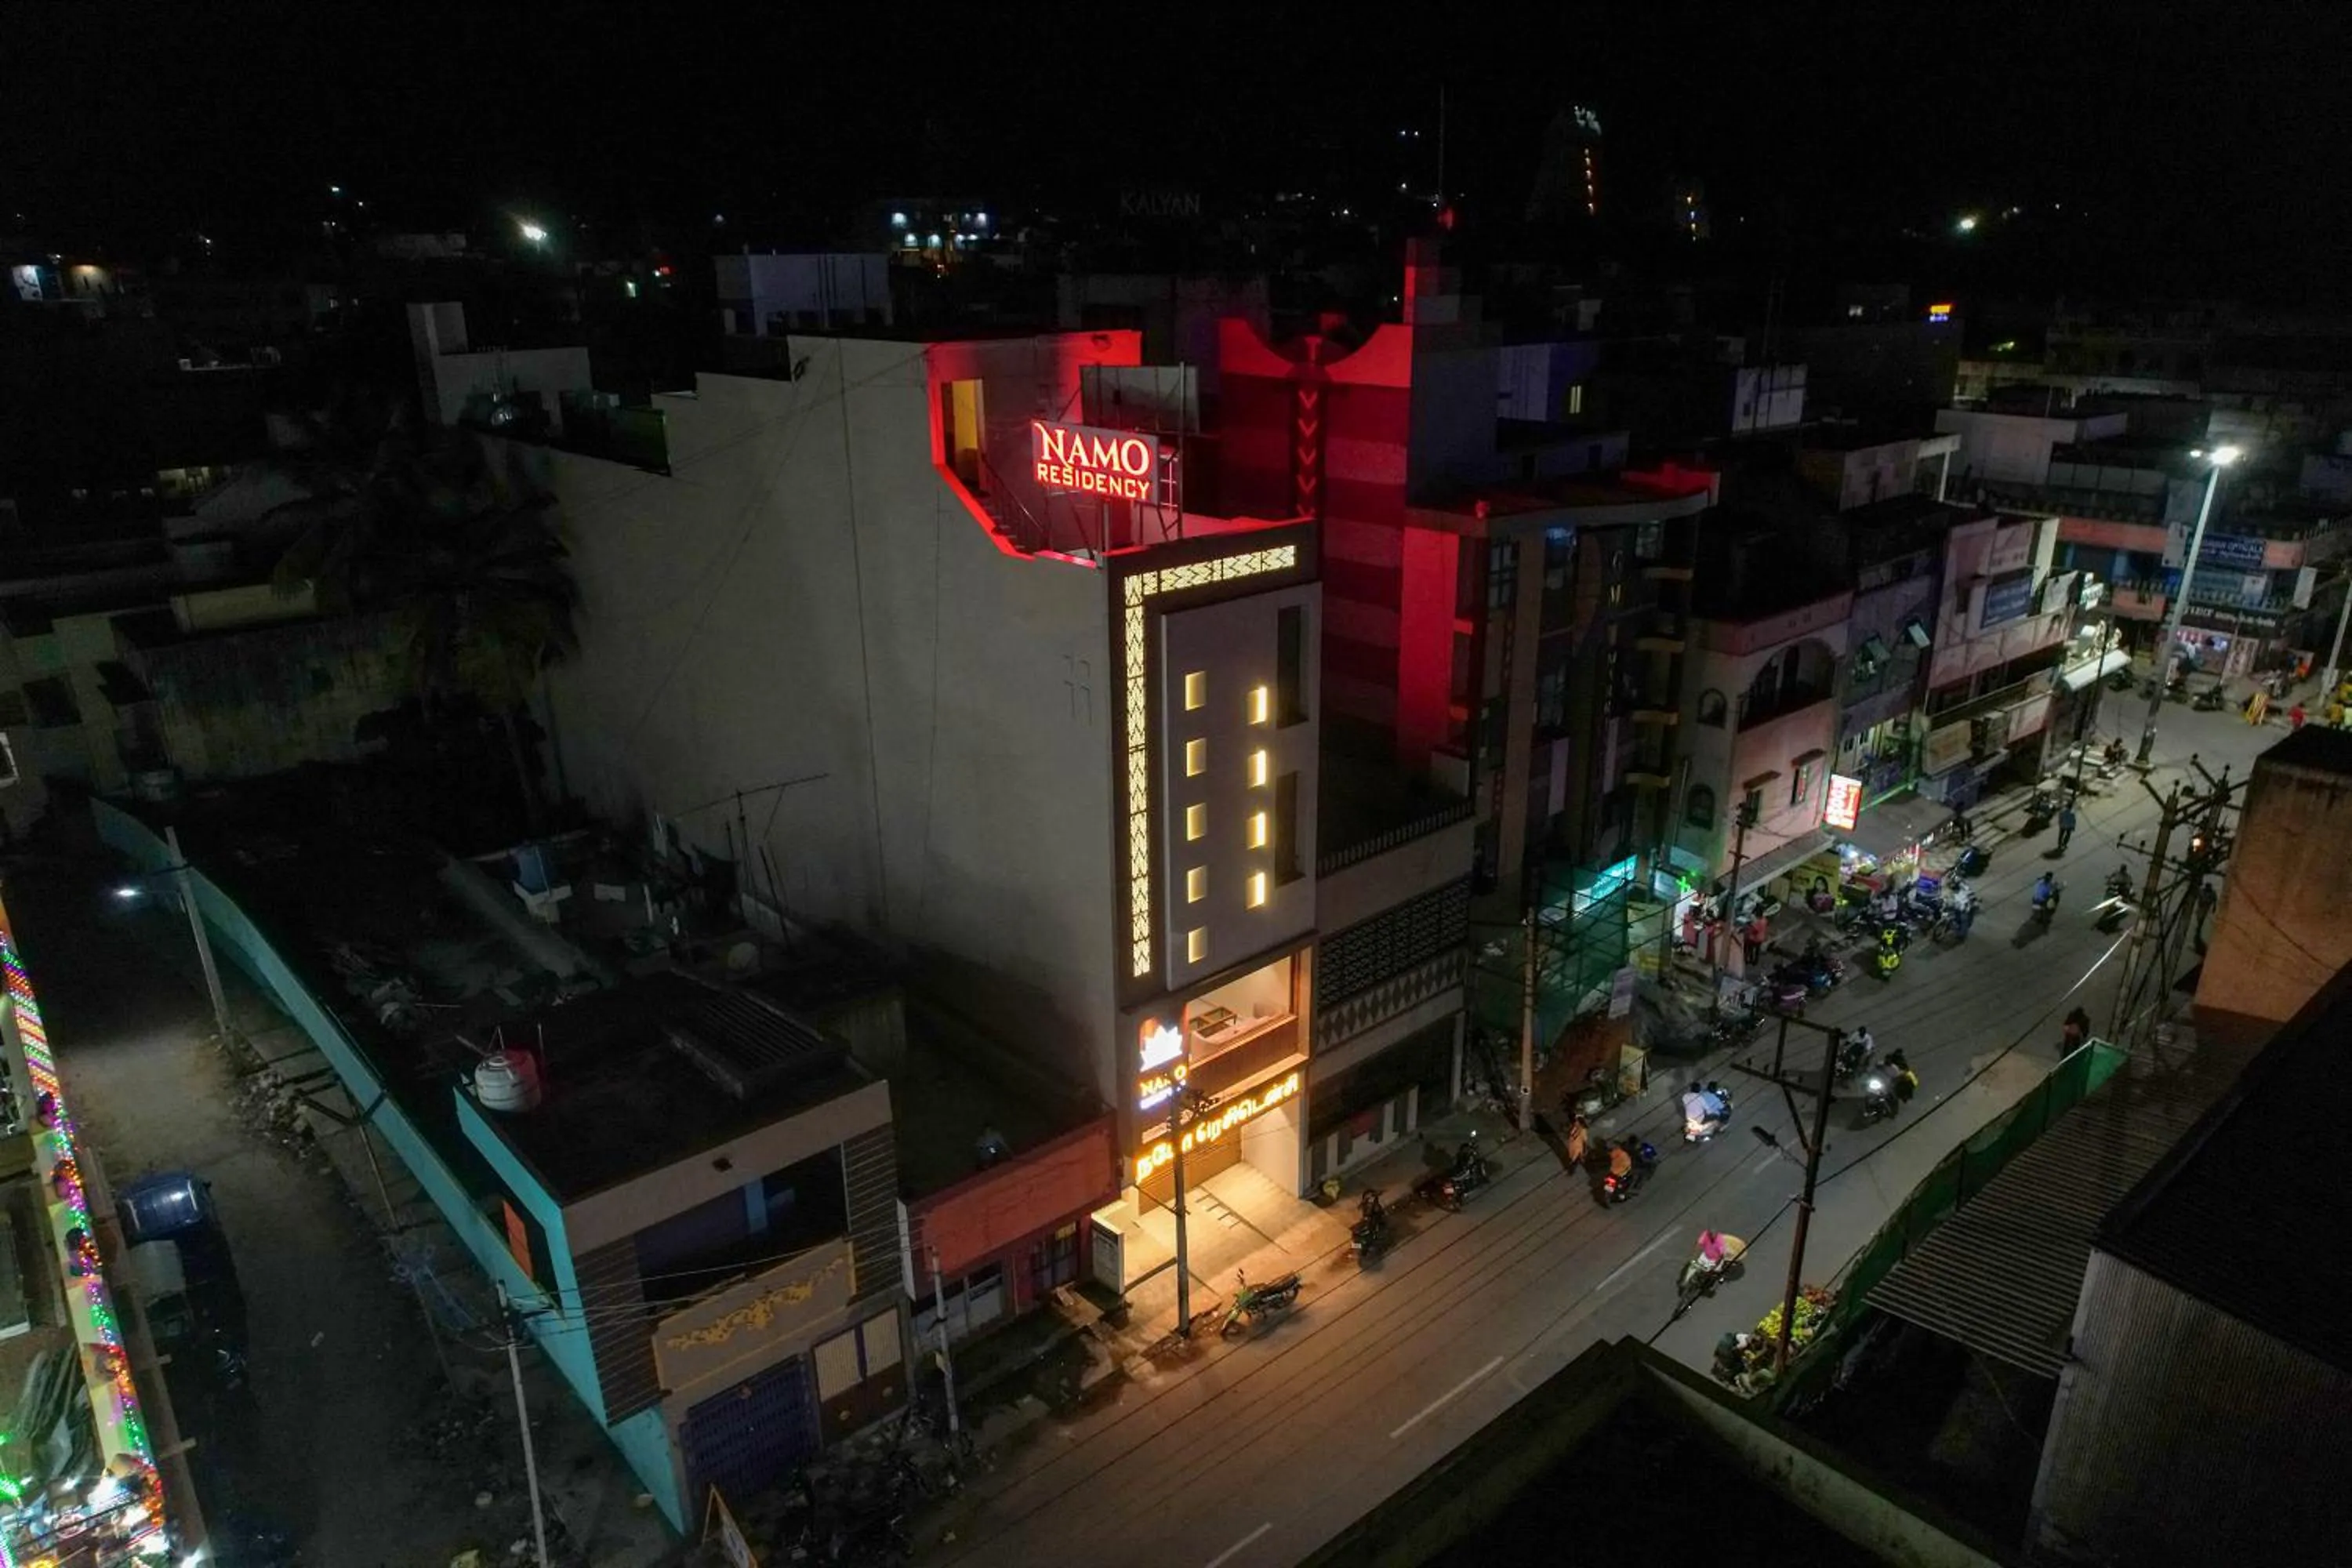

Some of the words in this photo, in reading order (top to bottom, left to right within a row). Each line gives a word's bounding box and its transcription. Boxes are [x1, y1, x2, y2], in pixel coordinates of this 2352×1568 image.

[1120, 191, 1201, 216] KALYAN
[1033, 422, 1150, 476] NAMO
[1036, 462, 1150, 500] RESIDENCY
[1140, 1065, 1187, 1097] NAO
